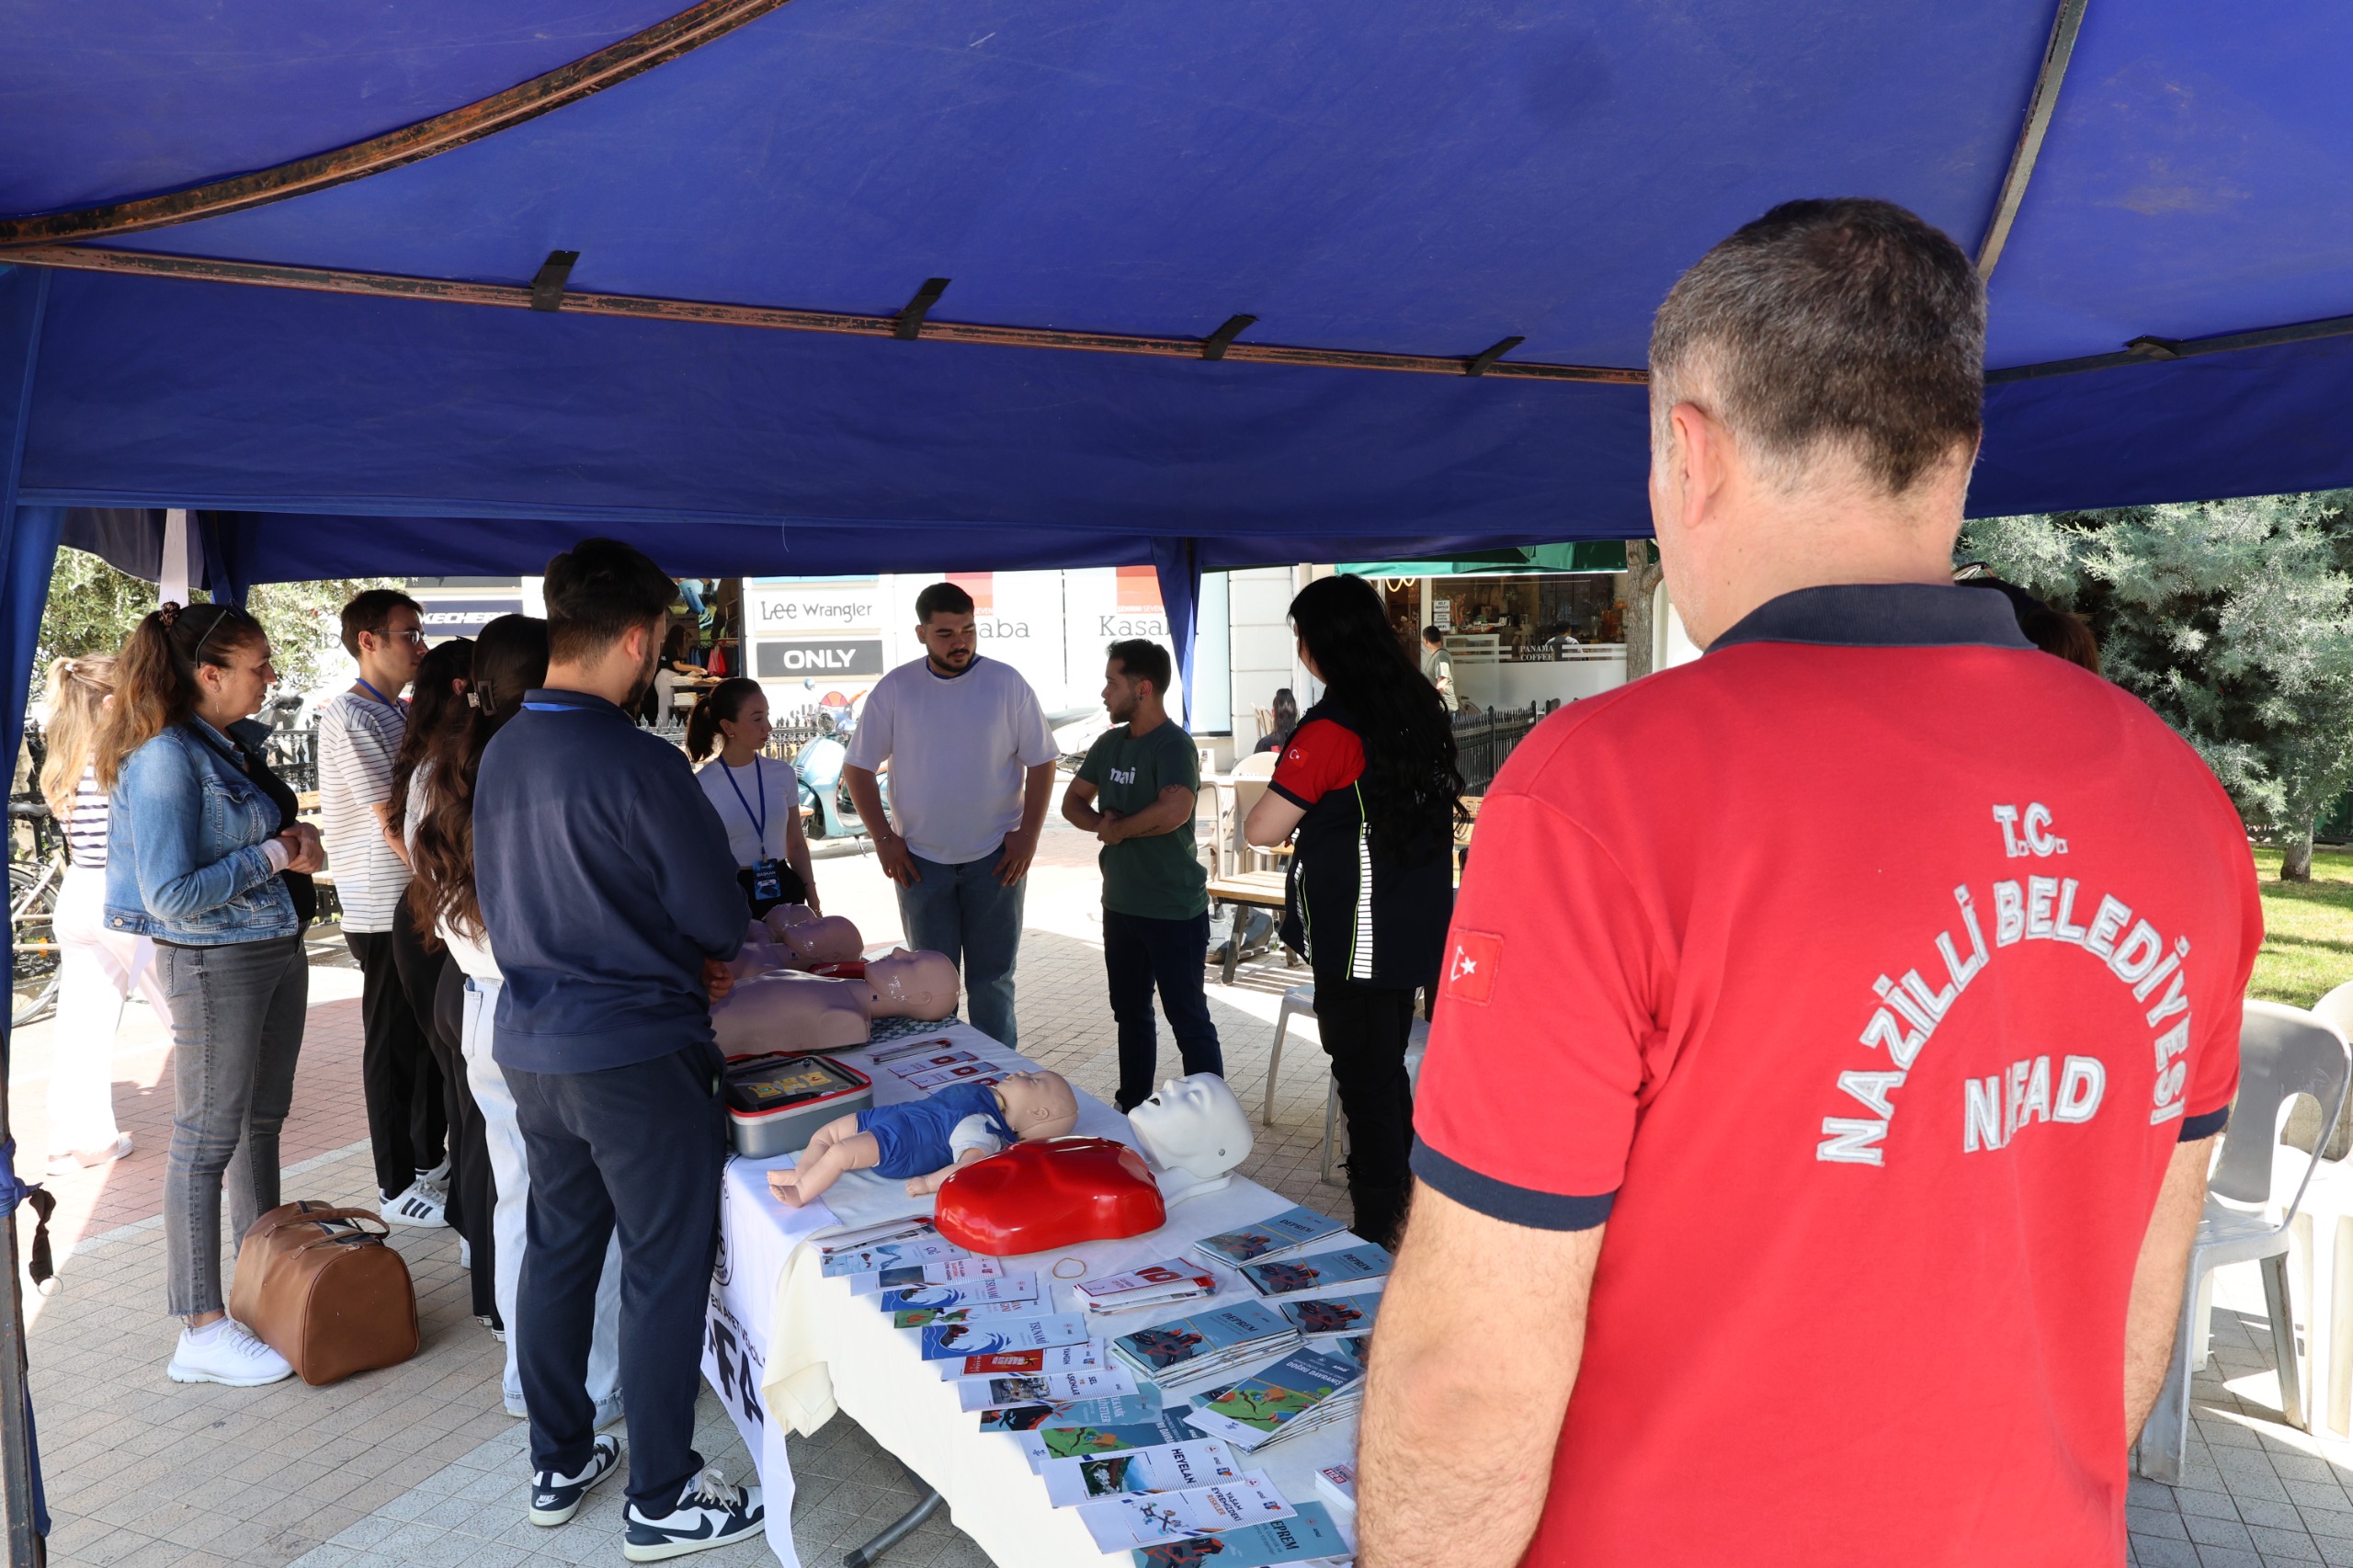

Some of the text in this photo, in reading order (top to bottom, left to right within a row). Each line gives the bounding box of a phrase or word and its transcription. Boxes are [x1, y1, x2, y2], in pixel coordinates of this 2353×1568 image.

[539, 575, 556, 584] NIKE
[419, 611, 512, 625] KECHER
[761, 601, 872, 622] Lee Wrangler
[979, 618, 1030, 639] aba
[1099, 613, 1199, 636] Kasa
[783, 649, 857, 669] ONLY
[1519, 644, 1554, 653] PANAMA
[1520, 653, 1553, 662] COFFEE
[1993, 801, 2068, 858] T.C.
[1816, 884, 1990, 1166] NAZİLLİ
[1279, 1218, 1313, 1233] DEPREM
[1343, 1253, 1372, 1271] DEPREM
[984, 1278, 1001, 1299] TSUNAMİ
[1029, 1321, 1049, 1344] TSUNAMİ
[1221, 1312, 1258, 1332] DEPREM
[1286, 1360, 1310, 1372] DOĞRU
[1308, 1369, 1343, 1385] DAVRANIŞ
[1332, 1364, 1349, 1372] AFAD
[1065, 1372, 1079, 1395] AŞKINLAR
[1088, 1376, 1097, 1385] SEL
[1097, 1398, 1110, 1423] LİYETLER
[1110, 1395, 1125, 1417] OLKANİK
[1171, 1448, 1196, 1483] HEYELAN
[1206, 1494, 1226, 1516] RİSKLER
[1211, 1486, 1243, 1521] EVREMİZDEKİ
[1225, 1492, 1243, 1510] YAŞAM
[1269, 1518, 1299, 1551] EPREM
